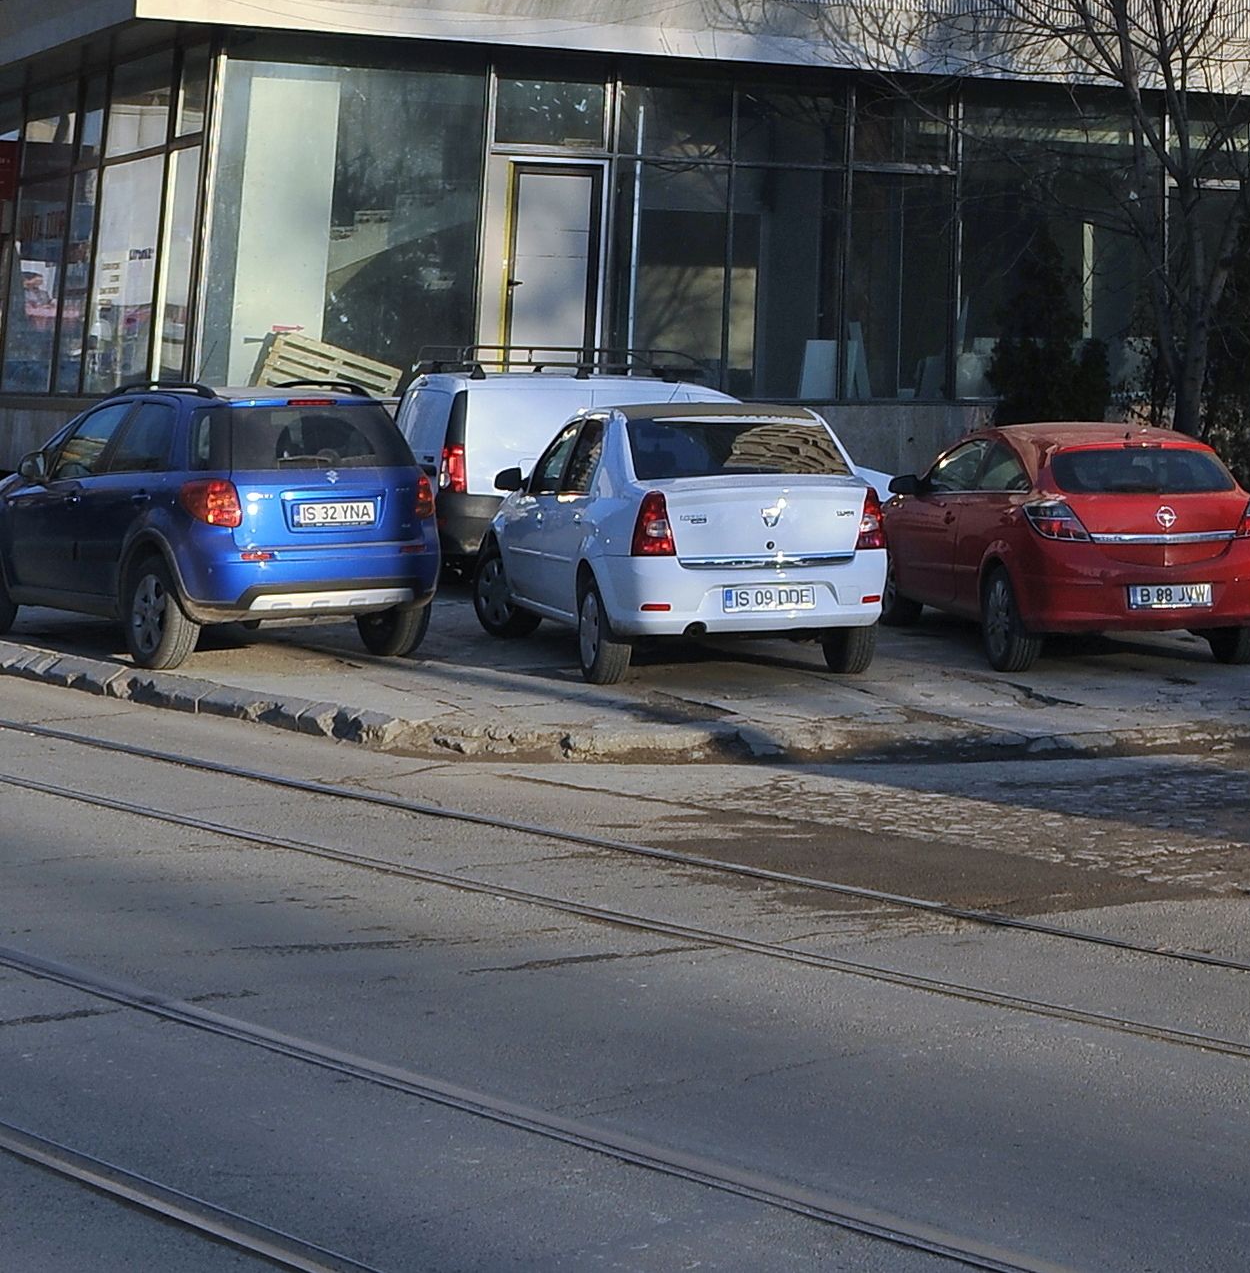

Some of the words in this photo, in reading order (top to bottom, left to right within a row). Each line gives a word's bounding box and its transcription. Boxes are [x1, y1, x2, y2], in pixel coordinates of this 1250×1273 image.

[302, 506, 316, 521] IS
[320, 506, 338, 520] 32
[341, 504, 372, 519] YNA
[735, 591, 750, 607] IS
[754, 590, 773, 606] 09
[778, 588, 811, 604] DDE
[1140, 588, 1151, 603] B
[1155, 587, 1173, 602] 88
[1178, 586, 1206, 602] JVW
